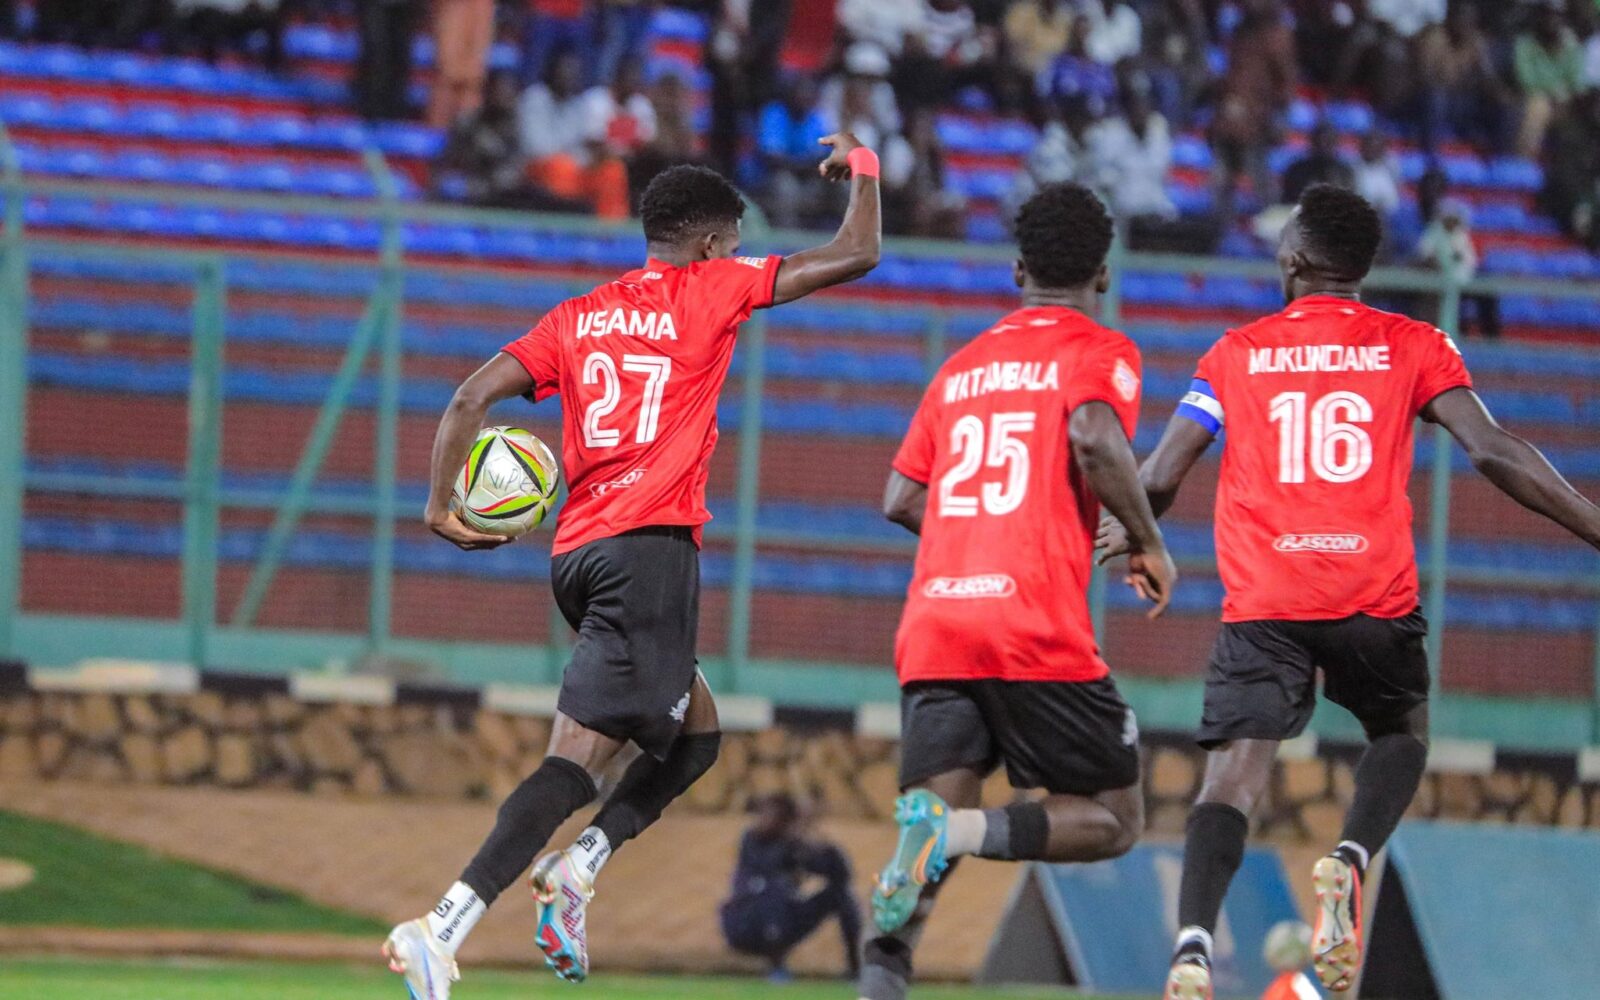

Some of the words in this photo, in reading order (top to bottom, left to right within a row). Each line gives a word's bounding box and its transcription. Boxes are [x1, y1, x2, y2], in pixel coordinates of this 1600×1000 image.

[576, 307, 678, 340] USAMA
[1248, 345, 1391, 374] MUKUNDANE
[582, 351, 672, 448] 27
[939, 412, 1036, 517] 25
[1269, 390, 1373, 484] 16
[1279, 536, 1360, 550] PLASCON
